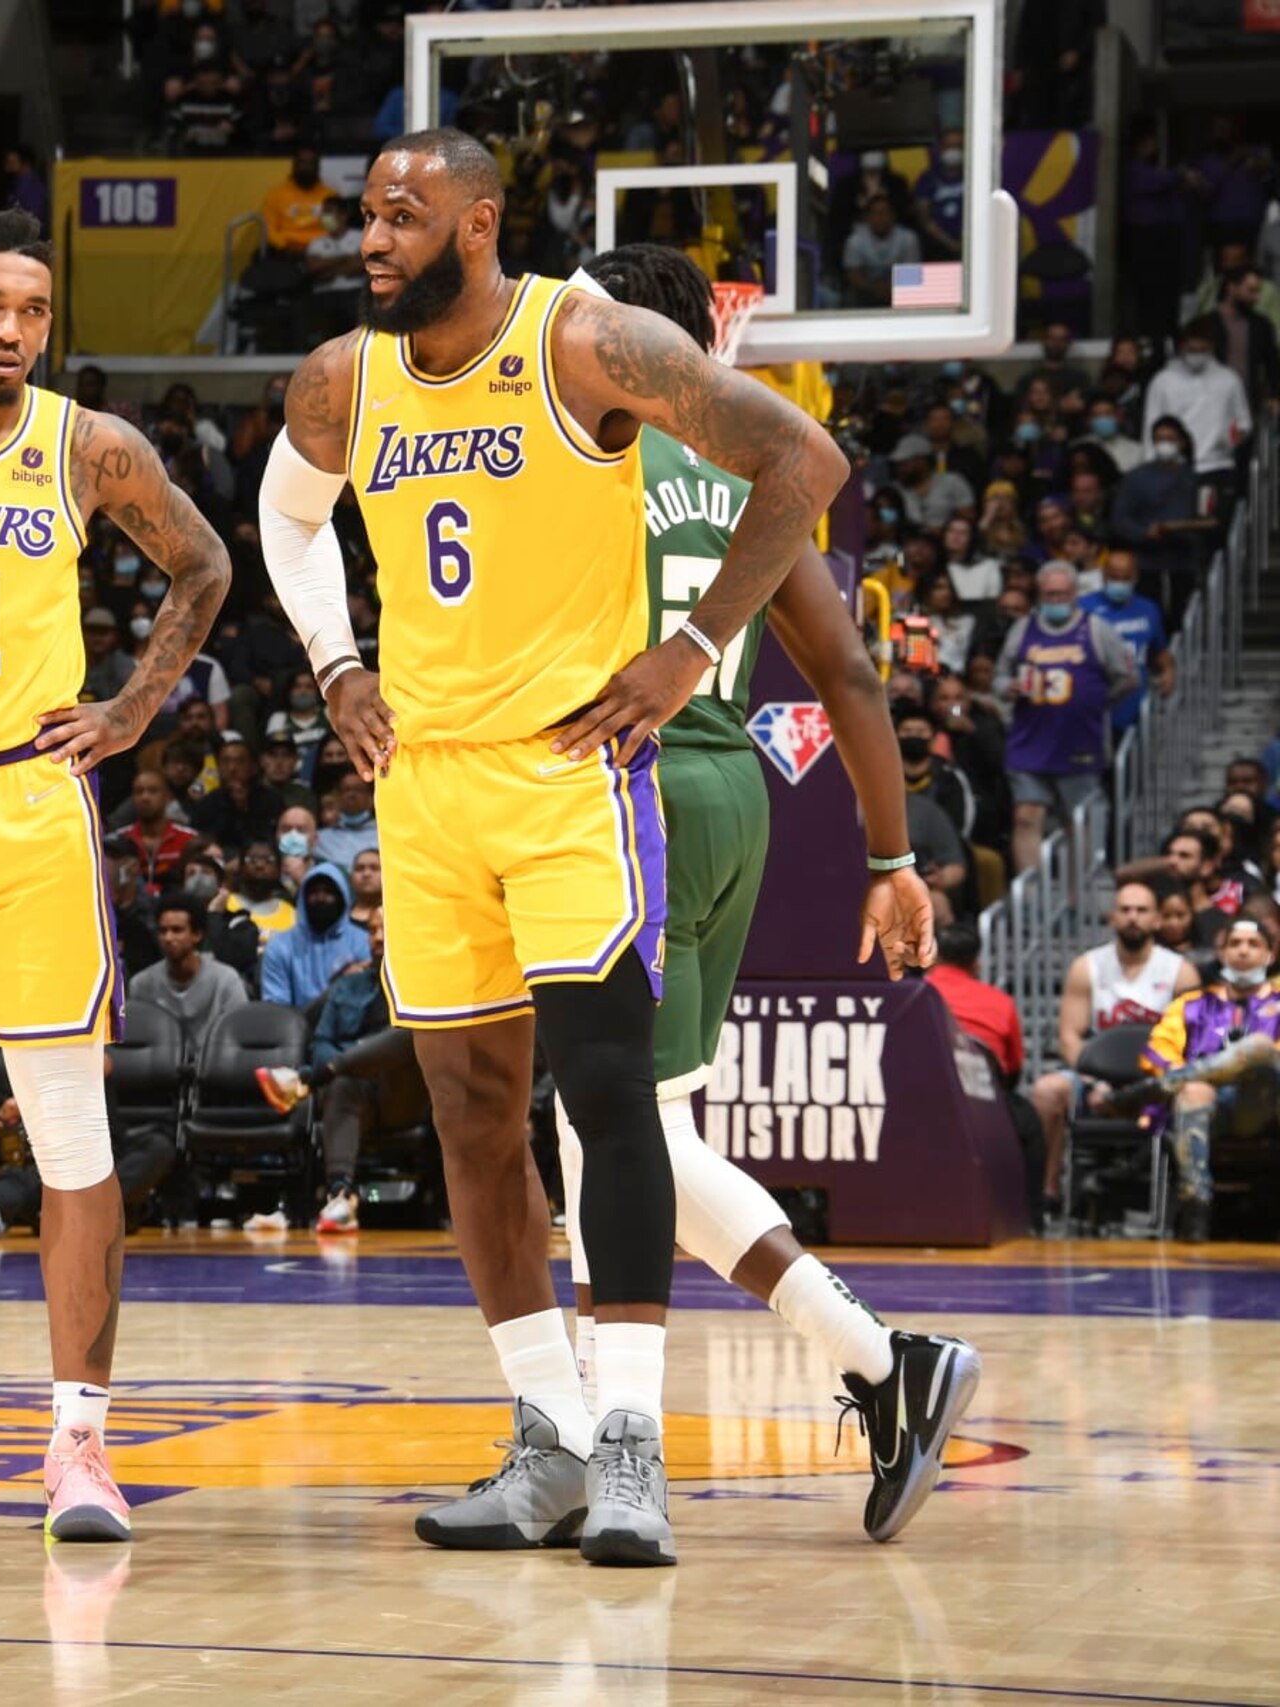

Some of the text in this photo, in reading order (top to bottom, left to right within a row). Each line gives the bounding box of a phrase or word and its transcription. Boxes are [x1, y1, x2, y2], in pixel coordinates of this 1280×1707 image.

[95, 183, 158, 222] 106
[489, 381, 532, 396] bibigo
[11, 469, 53, 486] bibigo
[366, 425, 524, 493] LAKERS
[425, 501, 471, 599] 6
[732, 996, 884, 1018] UILT BY
[704, 1021, 887, 1105] BLACK
[704, 1103, 886, 1162] HISTORY
